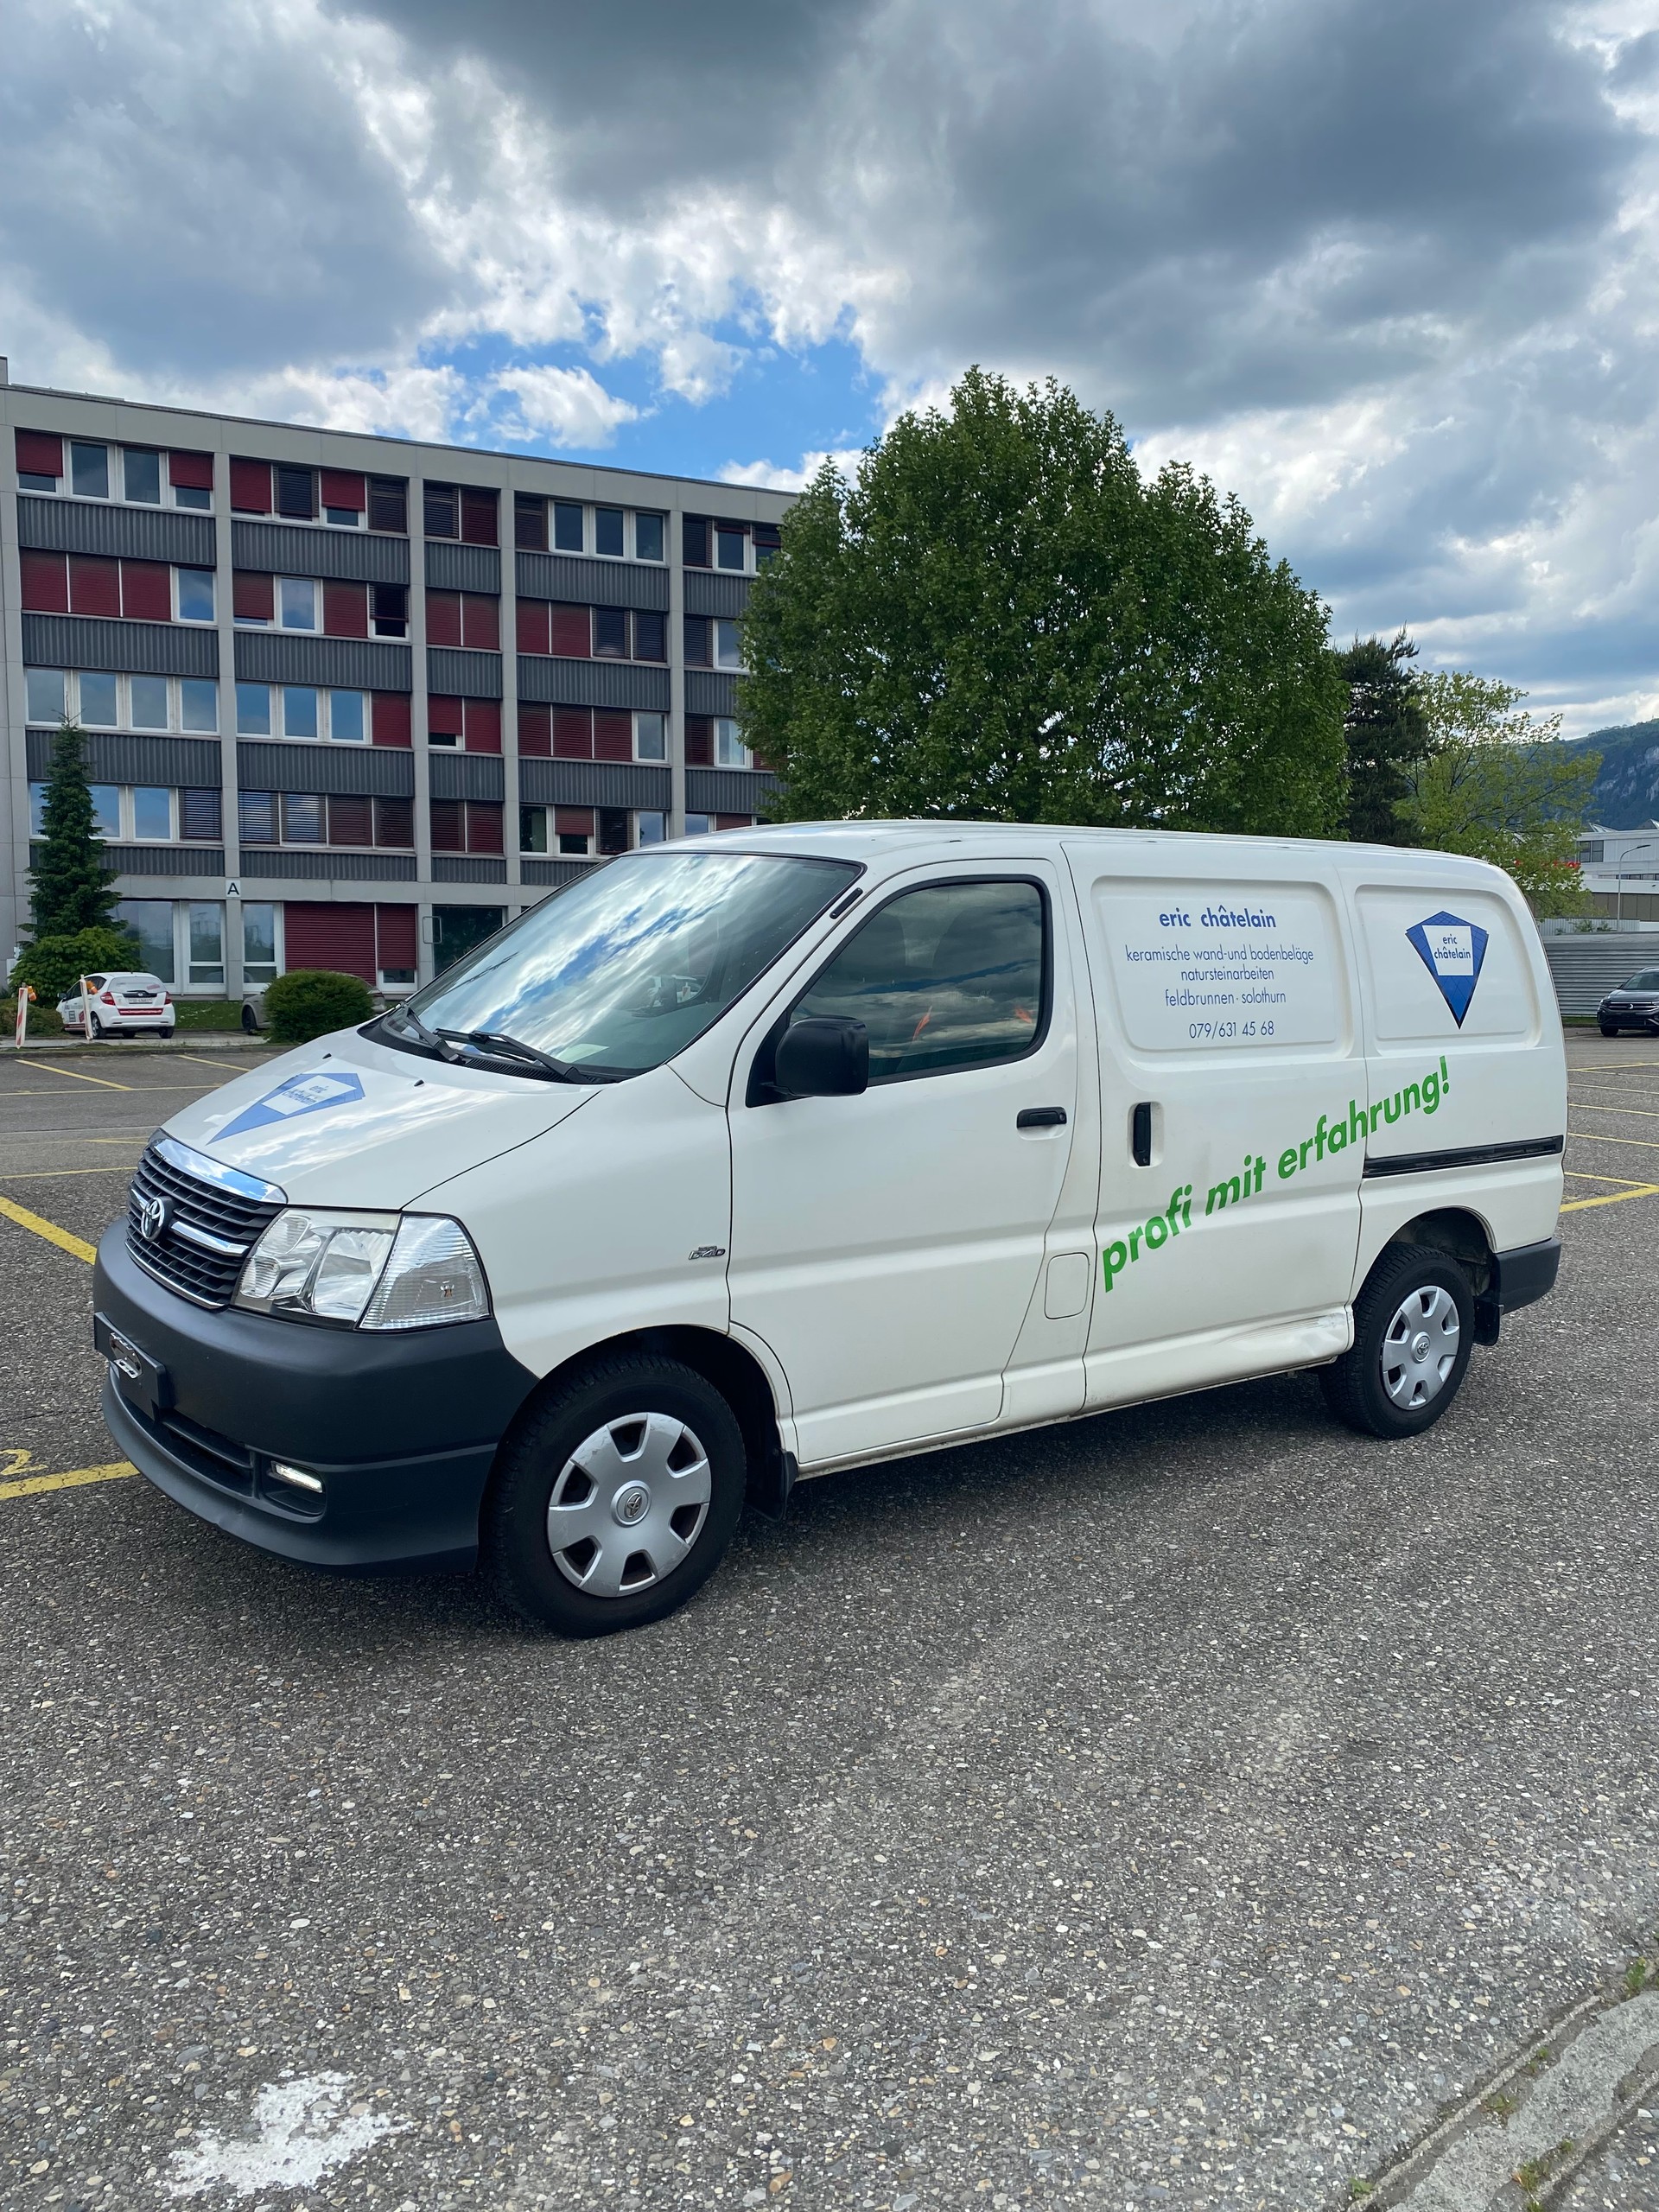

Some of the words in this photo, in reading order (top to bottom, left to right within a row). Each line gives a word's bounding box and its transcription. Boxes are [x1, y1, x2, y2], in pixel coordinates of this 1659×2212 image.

[227, 882, 240, 895] A
[1159, 907, 1192, 927] eric
[1200, 905, 1277, 928] châtelain
[1442, 933, 1458, 944] eric
[1125, 944, 1191, 962] keramische
[1249, 944, 1314, 965] bodenbeläge
[1433, 946, 1471, 959] châtelain
[1180, 963, 1274, 982] natursteinarbeiten
[1165, 988, 1235, 1007] feldbrunnen
[1241, 987, 1287, 1005] solothurn
[1189, 1020, 1236, 1039] 079/631
[1242, 1020, 1256, 1037] 45
[1260, 1020, 1274, 1036] 68
[1103, 1184, 1192, 1293] profi
[1205, 1154, 1266, 1216] mit
[1278, 1055, 1450, 1179] erfahrung!
